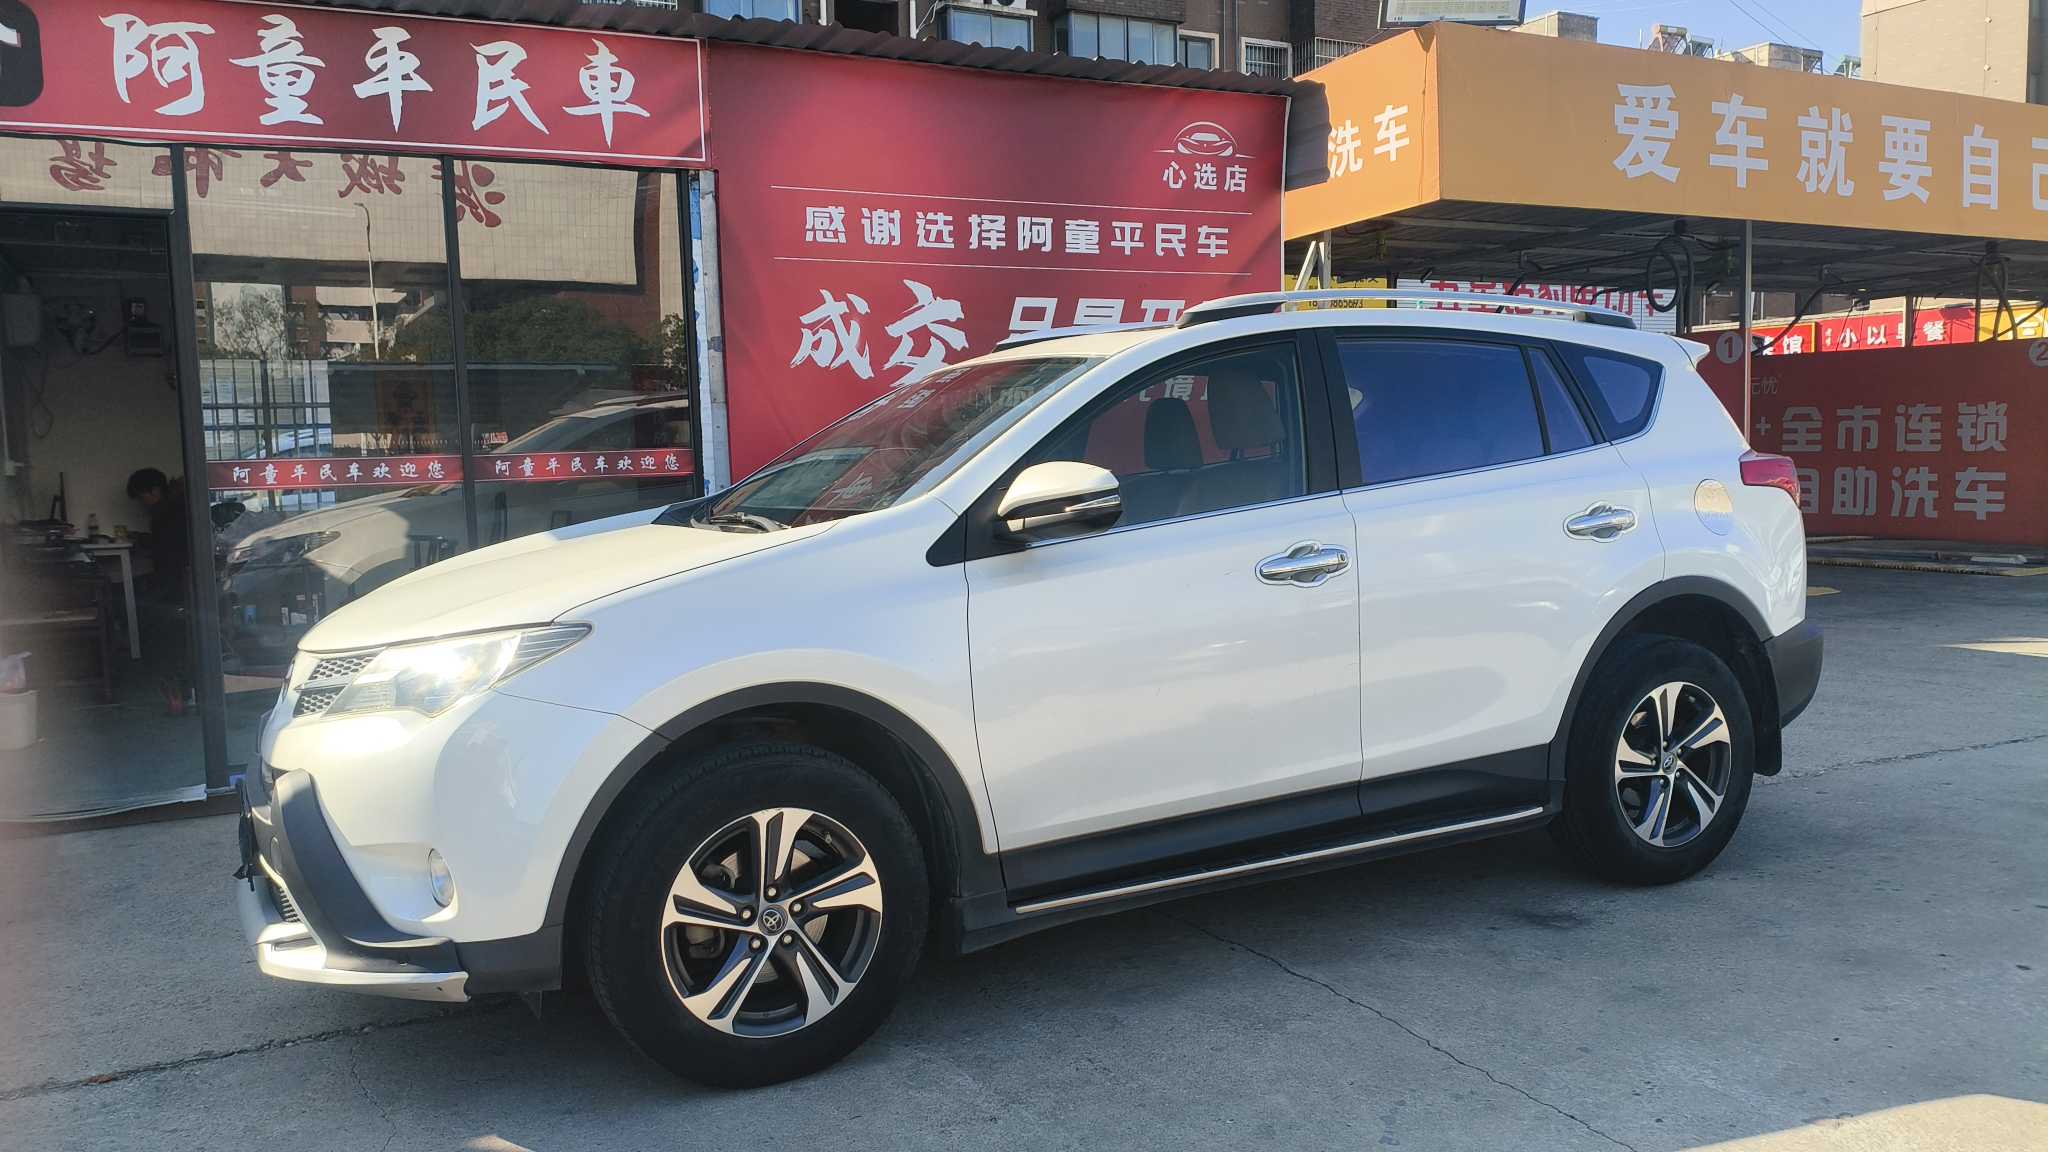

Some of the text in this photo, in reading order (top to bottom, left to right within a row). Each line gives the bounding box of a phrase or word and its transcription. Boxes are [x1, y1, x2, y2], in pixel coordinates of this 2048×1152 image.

[1328, 104, 1411, 179] 洗车
[1162, 161, 1249, 193] 心选店
[804, 205, 1230, 258] 感谢选择阿童平民车
[790, 279, 969, 388] 成交
[1781, 401, 2008, 452] 全市连锁
[232, 460, 446, 485] 阿童平民车欢迎您
[495, 453, 680, 477] 阿童平民车欢迎您
[1797, 465, 2006, 520] 自助洗车
